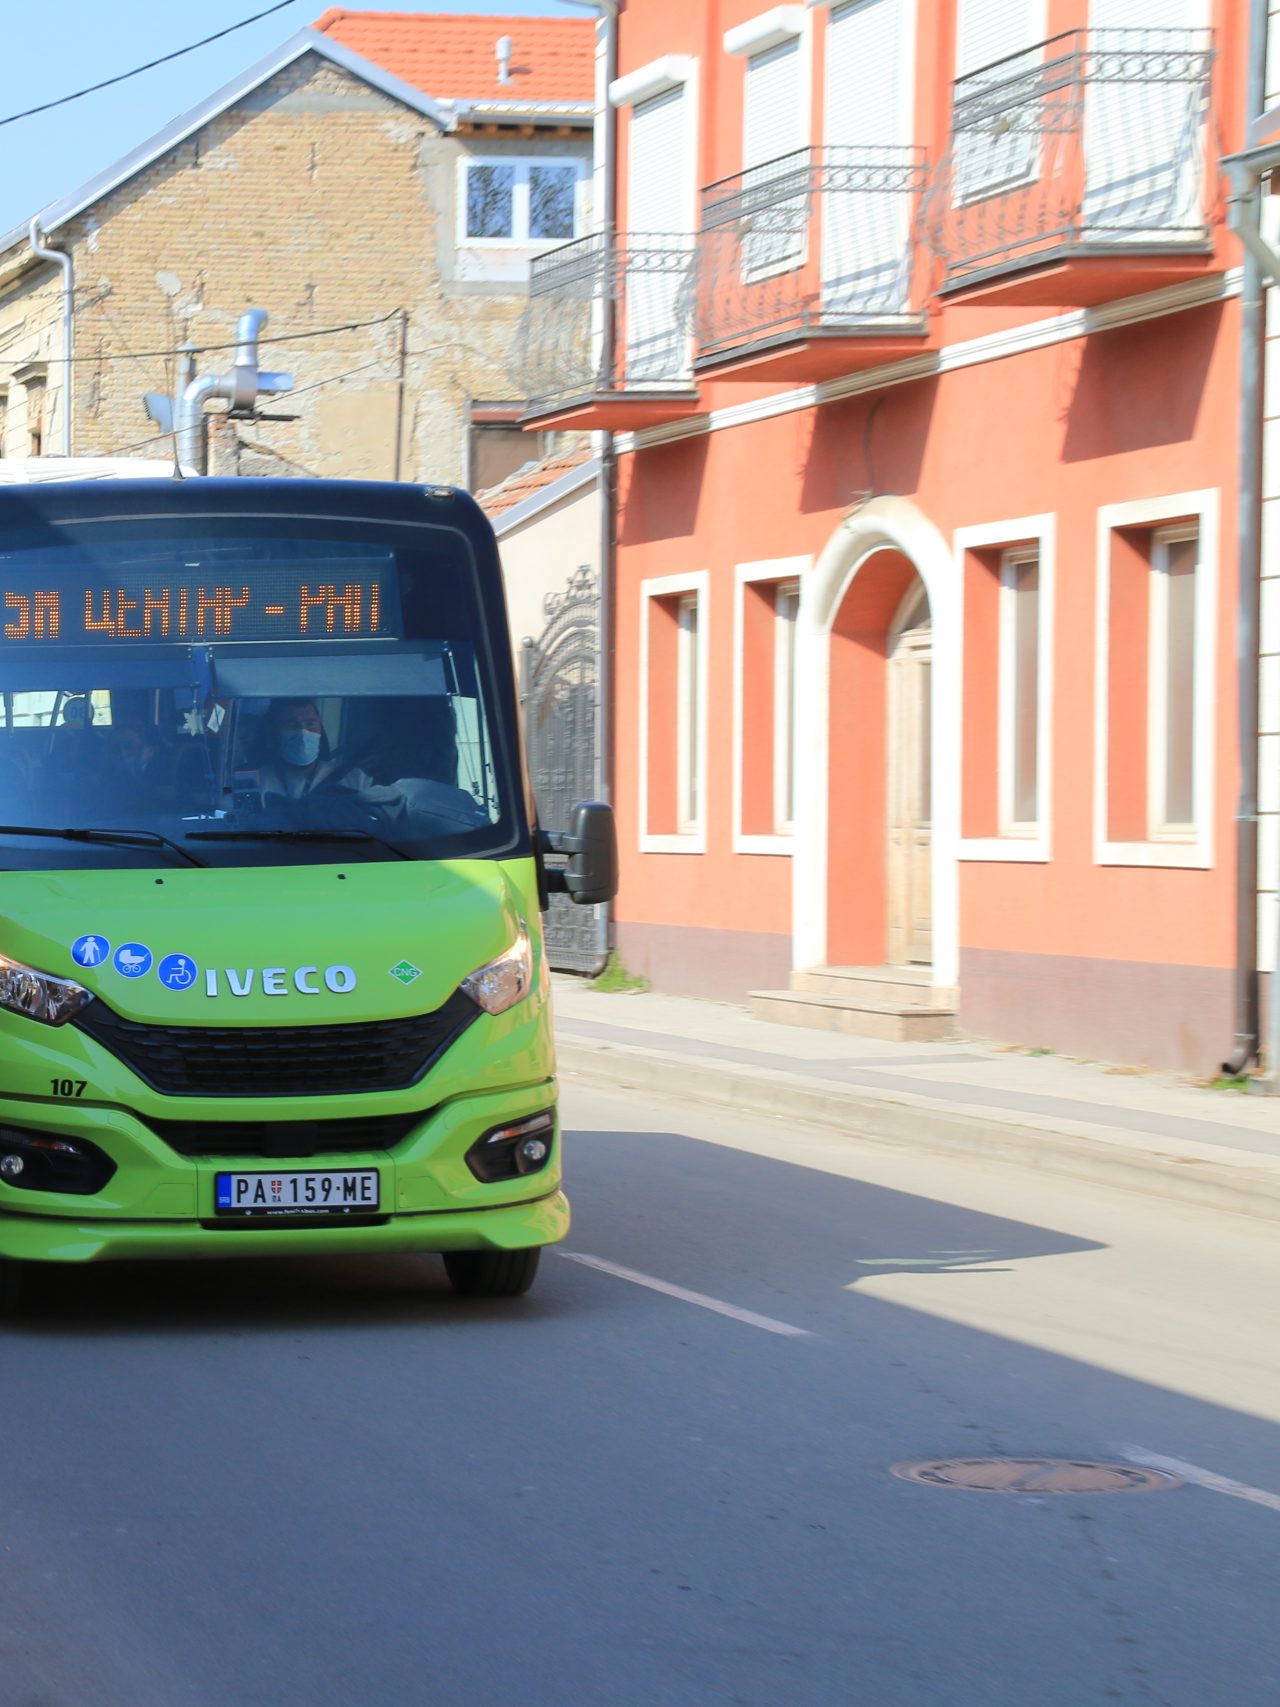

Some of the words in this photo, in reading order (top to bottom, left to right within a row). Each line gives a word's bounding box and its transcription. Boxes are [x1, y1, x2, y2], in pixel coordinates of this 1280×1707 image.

[205, 965, 357, 997] IVECO
[393, 967, 418, 977] CNG
[50, 1078, 87, 1098] 107
[236, 1178, 267, 1203] PA
